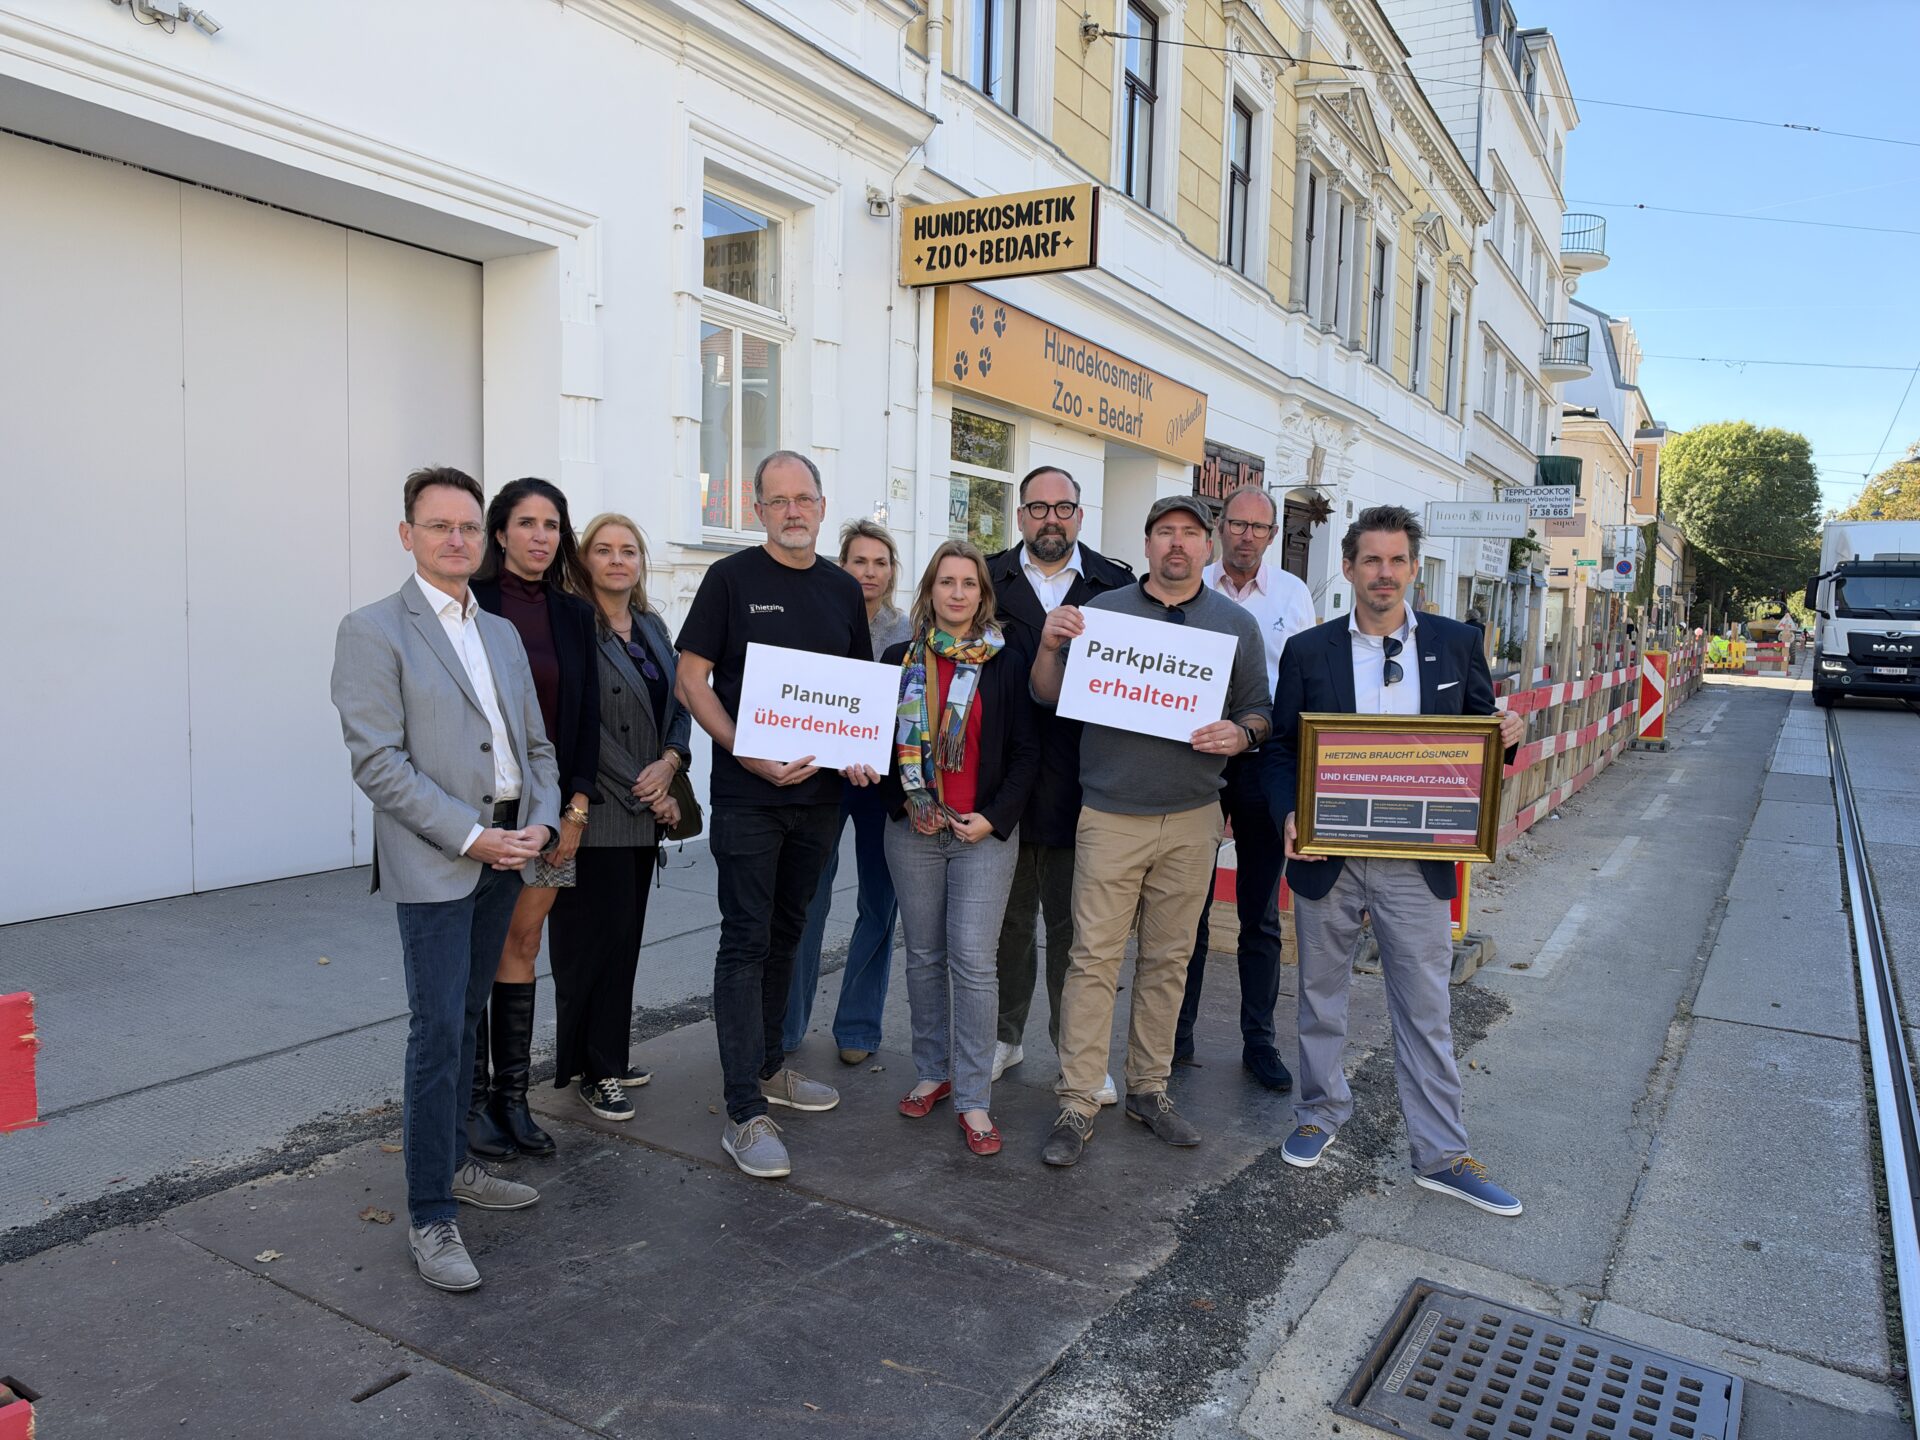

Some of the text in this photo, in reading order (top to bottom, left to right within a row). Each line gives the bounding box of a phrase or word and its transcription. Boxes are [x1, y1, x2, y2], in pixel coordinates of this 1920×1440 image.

[914, 196, 1075, 240] HUNDEKOSMETIK
[979, 231, 1060, 265] BEDARF
[1044, 328, 1153, 402] Hundekosmetik
[1052, 379, 1083, 418] Zoo
[1099, 398, 1144, 438] Bedarf
[1505, 488, 1571, 496] TEPPICHDOKTOR
[1436, 511, 1466, 521] linen
[1487, 511, 1521, 523] living
[1540, 508, 1551, 516] 38
[1553, 508, 1569, 516] 665
[755, 603, 785, 613] hietzing
[1086, 640, 1214, 682] Parkplätze
[1872, 644, 1913, 653] MAN
[781, 684, 862, 714] Planung
[1088, 676, 1198, 713] erhalten!
[753, 708, 880, 741] überdenken!
[1325, 750, 1469, 759] HIETZING BRAUCHT LÖSUNGEN
[1320, 772, 1468, 785] UND KEINEN PARKPLATZ-RAUB!
